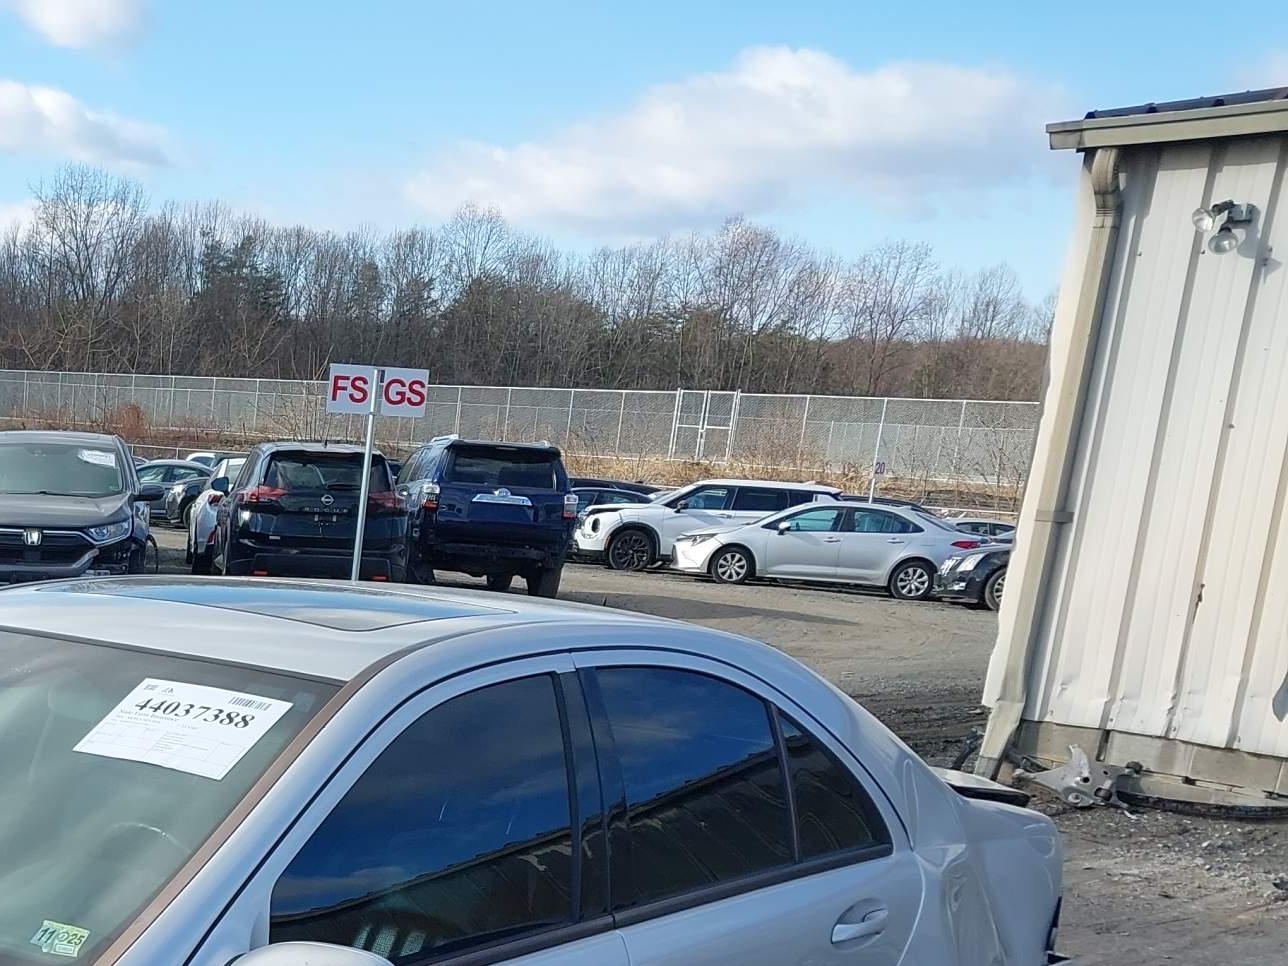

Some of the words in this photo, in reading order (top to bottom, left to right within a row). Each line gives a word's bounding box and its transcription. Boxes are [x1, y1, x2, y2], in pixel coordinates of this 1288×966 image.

[331, 375, 369, 403] FS
[384, 379, 426, 407] GS
[875, 462, 885, 474] 20
[135, 698, 256, 729] 44037388
